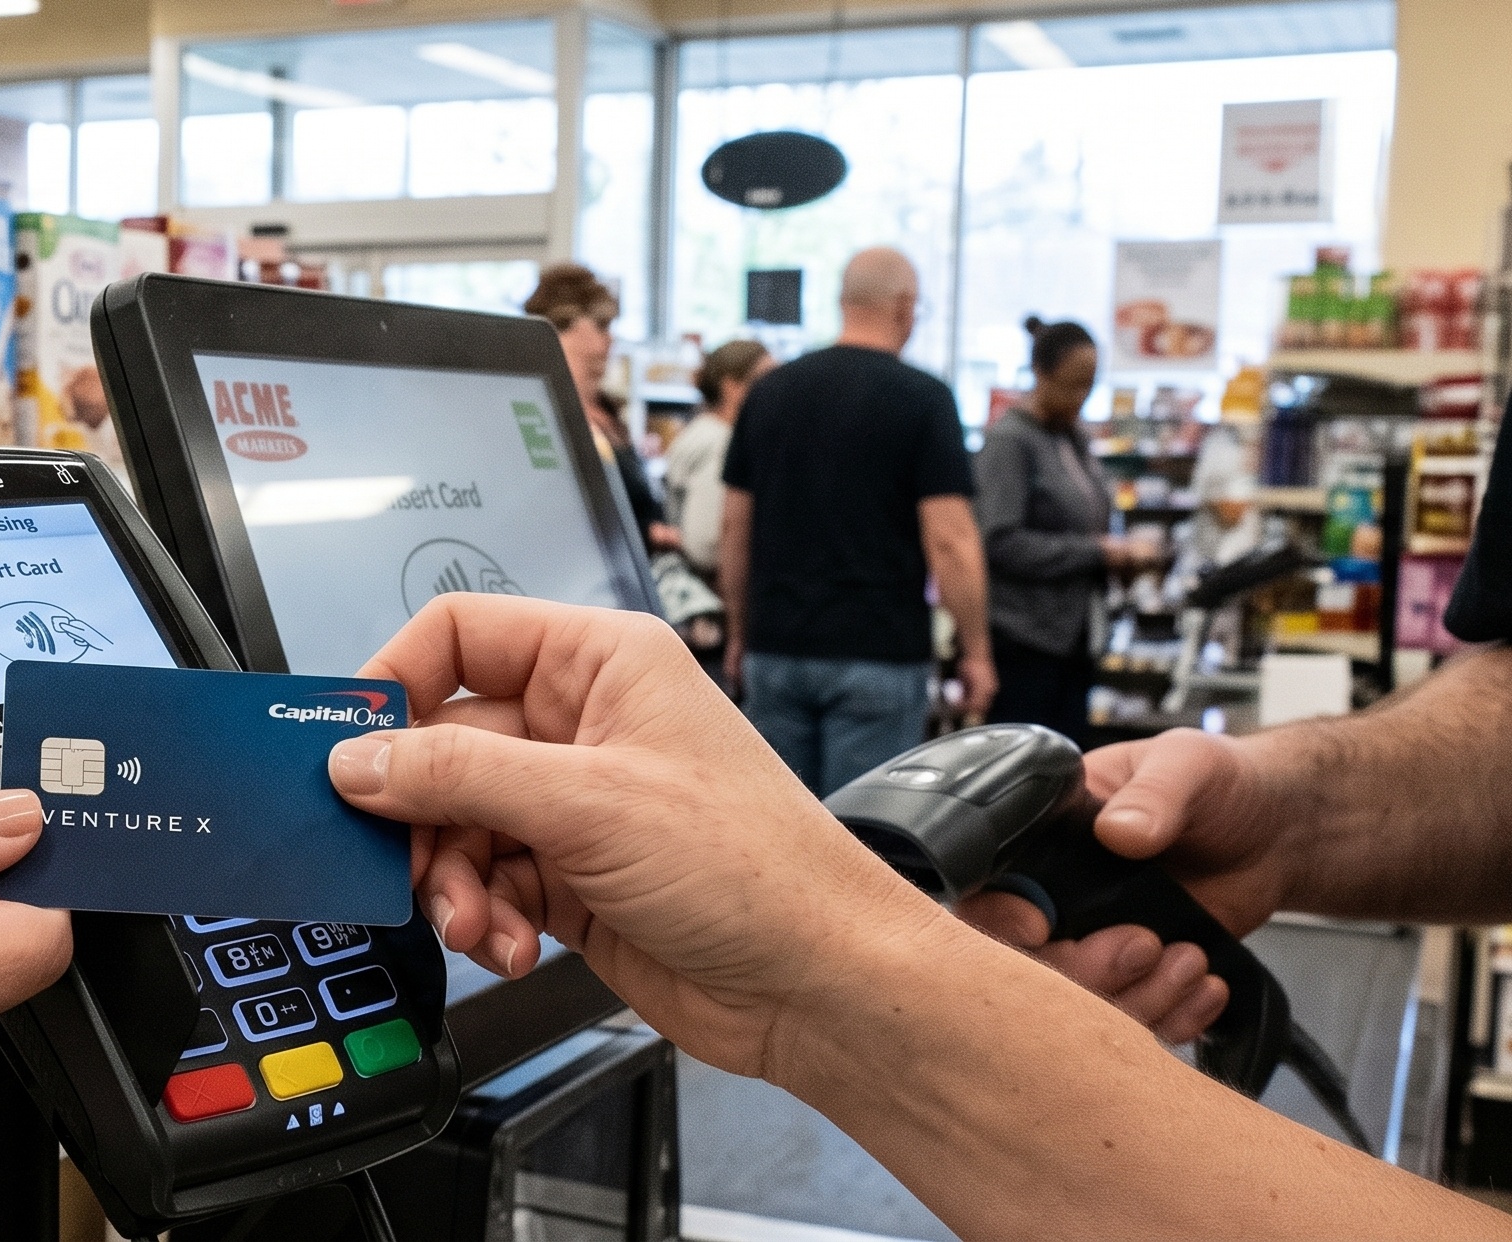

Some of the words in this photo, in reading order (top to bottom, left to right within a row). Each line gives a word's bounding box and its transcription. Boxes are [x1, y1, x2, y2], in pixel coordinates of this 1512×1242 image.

[212, 379, 299, 428] ACME
[438, 481, 483, 510] Card
[17, 558, 64, 576] Card
[42, 809, 183, 833] VENTURE
[196, 817, 213, 834] X
[311, 926, 334, 950] 9
[227, 947, 251, 971] 8
[255, 1001, 279, 1027] 0
